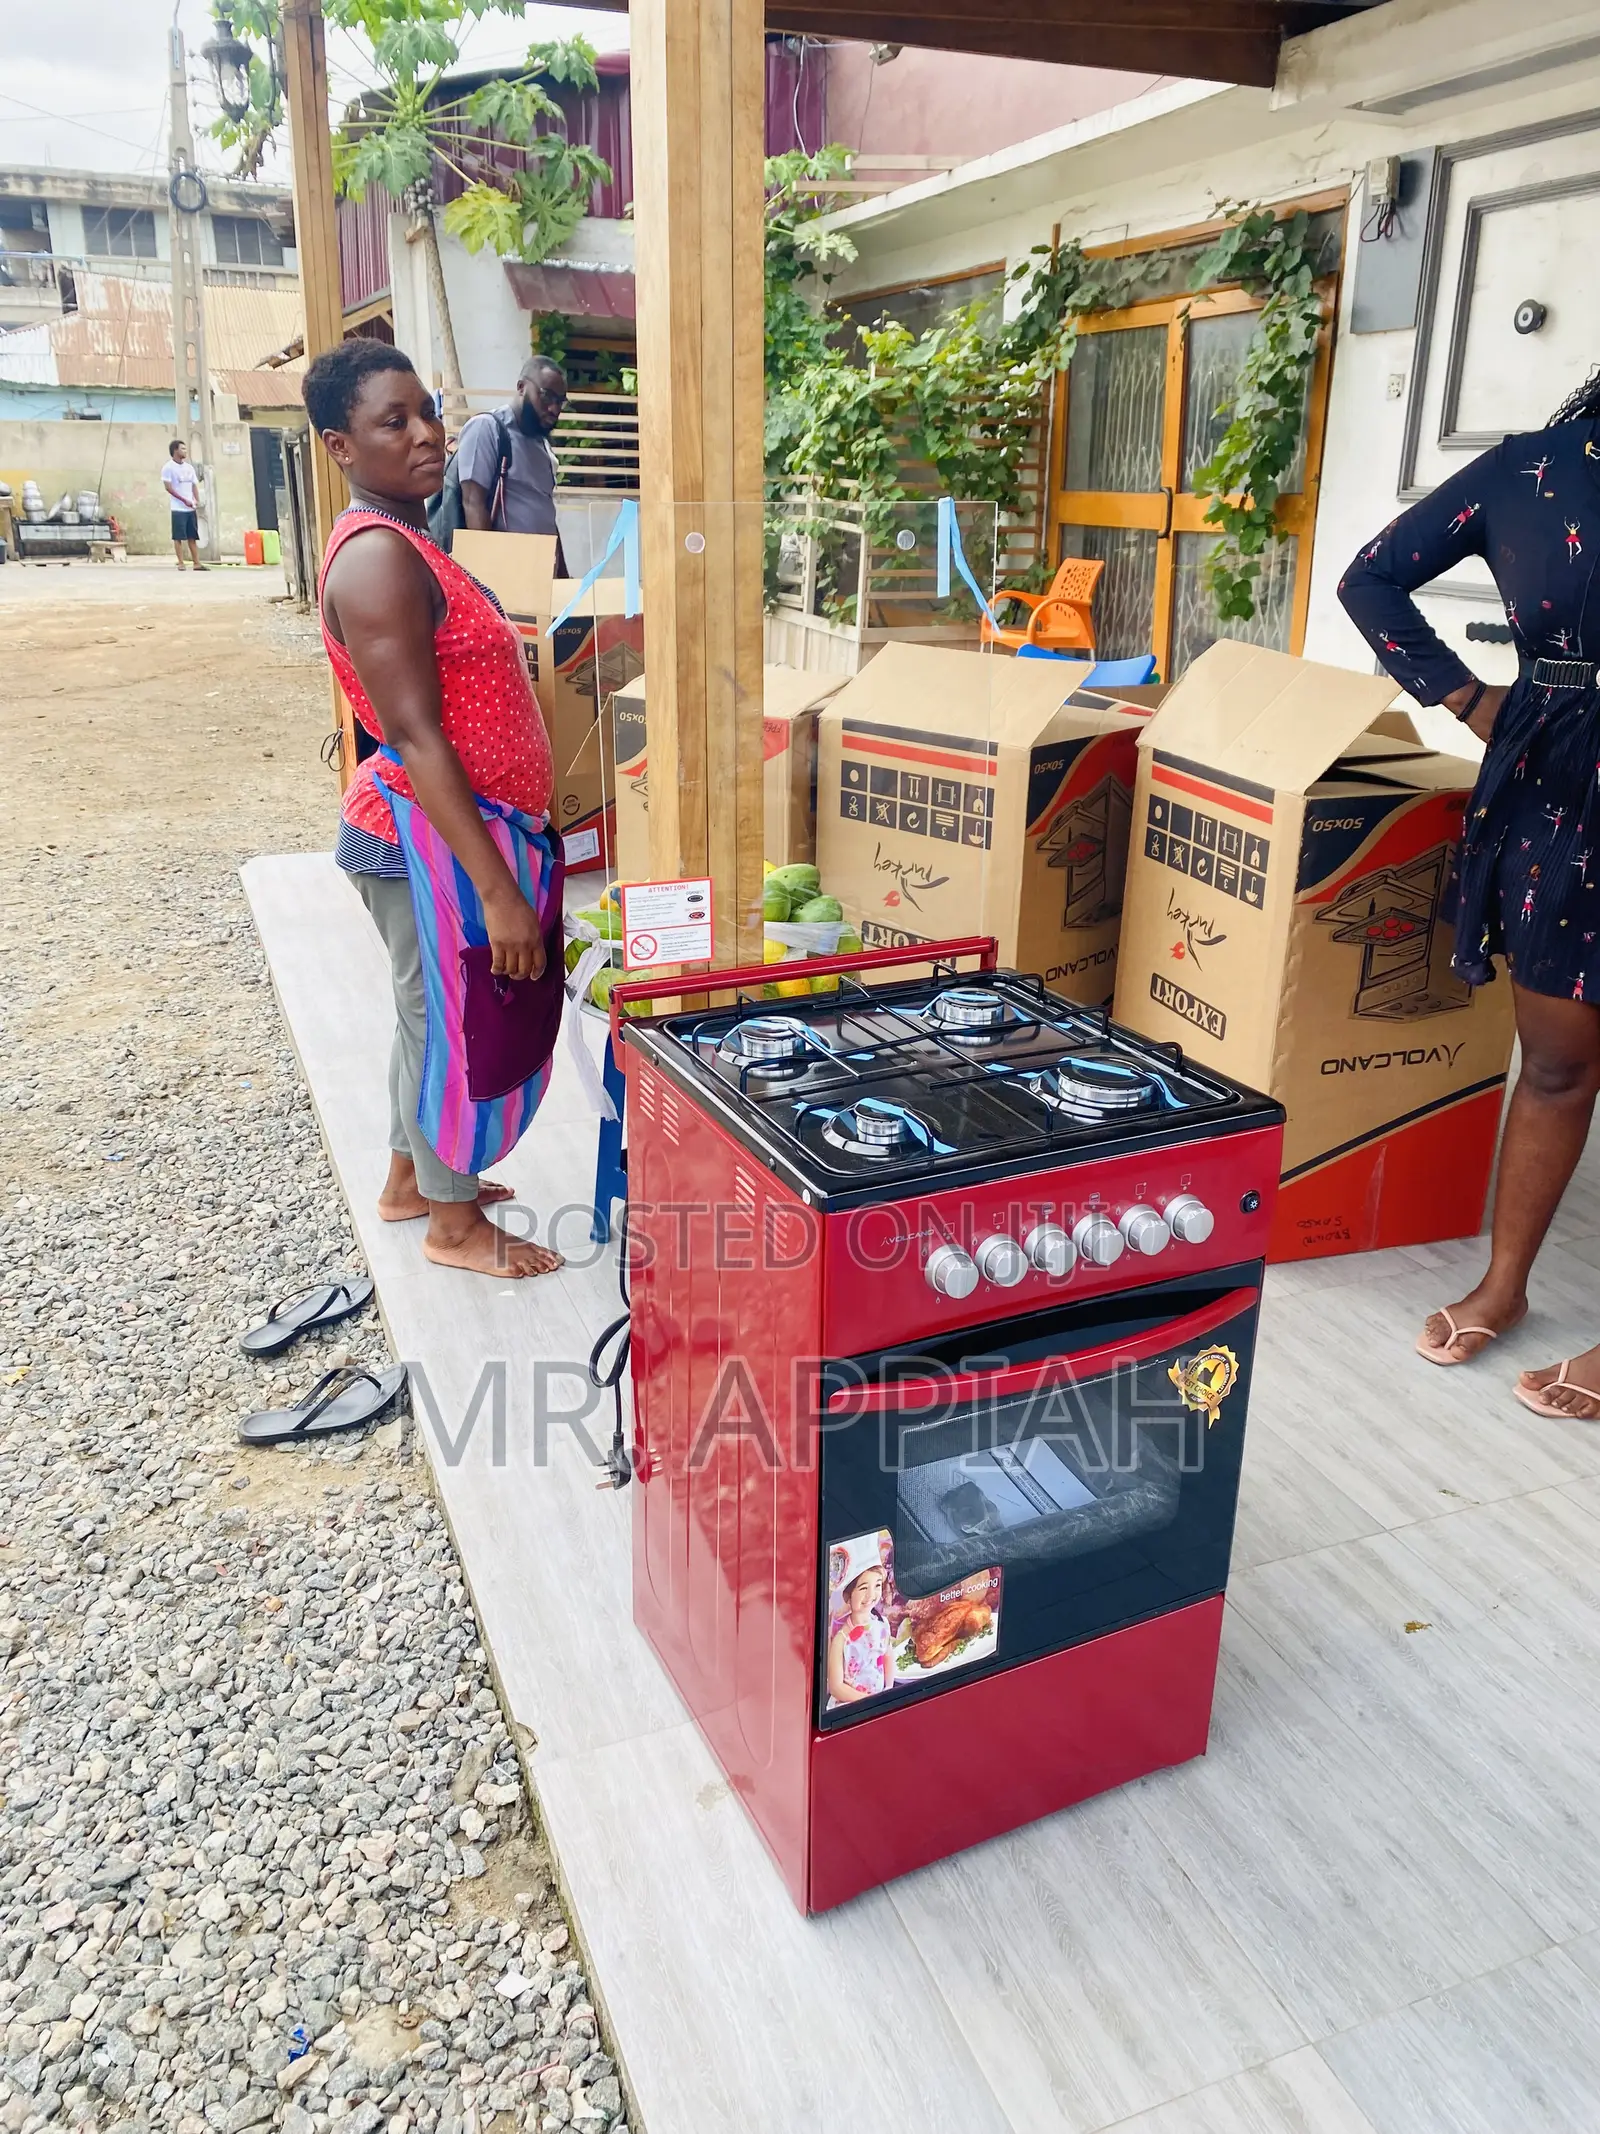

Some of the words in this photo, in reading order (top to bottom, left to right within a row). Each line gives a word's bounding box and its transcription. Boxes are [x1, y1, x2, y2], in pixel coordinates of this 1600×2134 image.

[619, 711, 646, 725] 0x50
[1034, 759, 1065, 774] 50x50
[1312, 817, 1365, 832] 50x50
[873, 842, 950, 907] Turkey
[648, 884, 689, 893] ATTENTION!
[1166, 887, 1227, 966] Turkey
[1046, 950, 1116, 982] VOLCANO
[1153, 978, 1225, 1037] EXPORT
[1321, 1047, 1442, 1075] VOLCANO
[889, 1229, 935, 1243] VOLCANO
[1193, 1385, 1215, 1402] CHOICE
[940, 1588, 965, 1603] better
[967, 1578, 999, 1594] cooking
